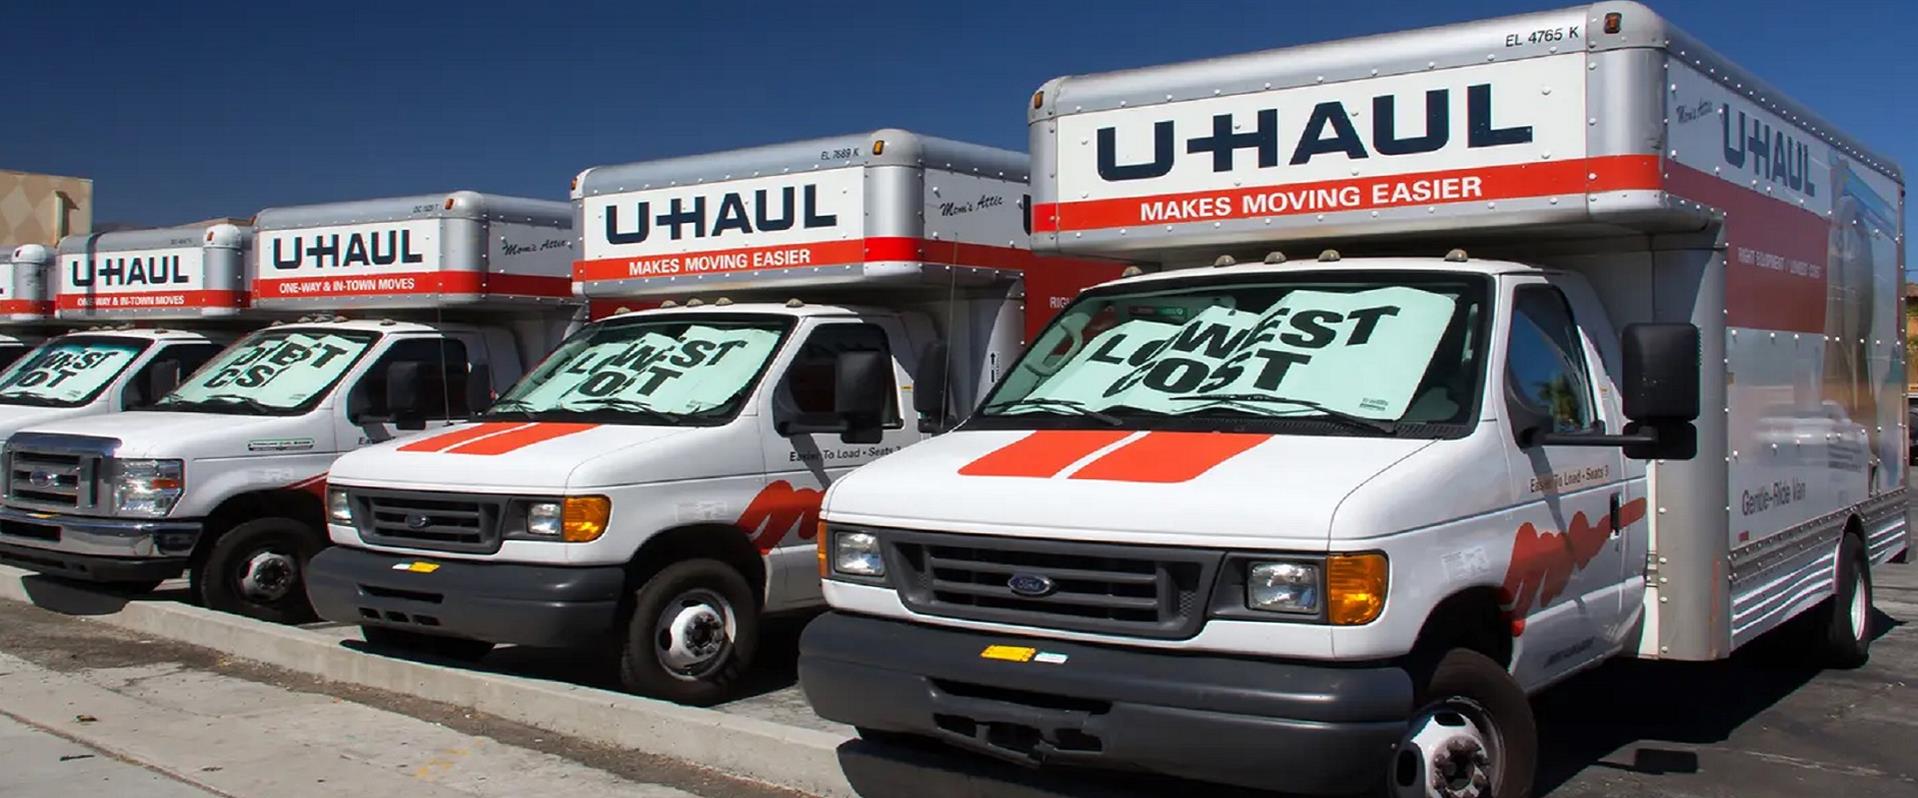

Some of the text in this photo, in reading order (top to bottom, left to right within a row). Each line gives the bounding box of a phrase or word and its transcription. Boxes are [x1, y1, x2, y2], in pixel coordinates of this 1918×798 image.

[1505, 25, 1579, 47] EL 4765 K
[1096, 83, 1533, 182] U-HAUL
[820, 150, 832, 160] EL
[1722, 103, 1815, 197] U-HAUL
[939, 201, 973, 217] Mom's
[1140, 176, 1482, 222] MAKES MOVING EASIER
[606, 184, 838, 245] U-HAUL
[273, 230, 423, 270] U-HAUL
[628, 249, 811, 276] MAKES MOVING EASIER
[72, 256, 189, 287] U-HAUL
[279, 277, 415, 294] ONE-WAY & IN-TOWN MOVES
[155, 294, 185, 305] MOVES
[1085, 305, 1401, 367] LOWEST
[823, 449, 835, 460] To
[837, 448, 860, 459] Load
[1564, 469, 1582, 486] Load
